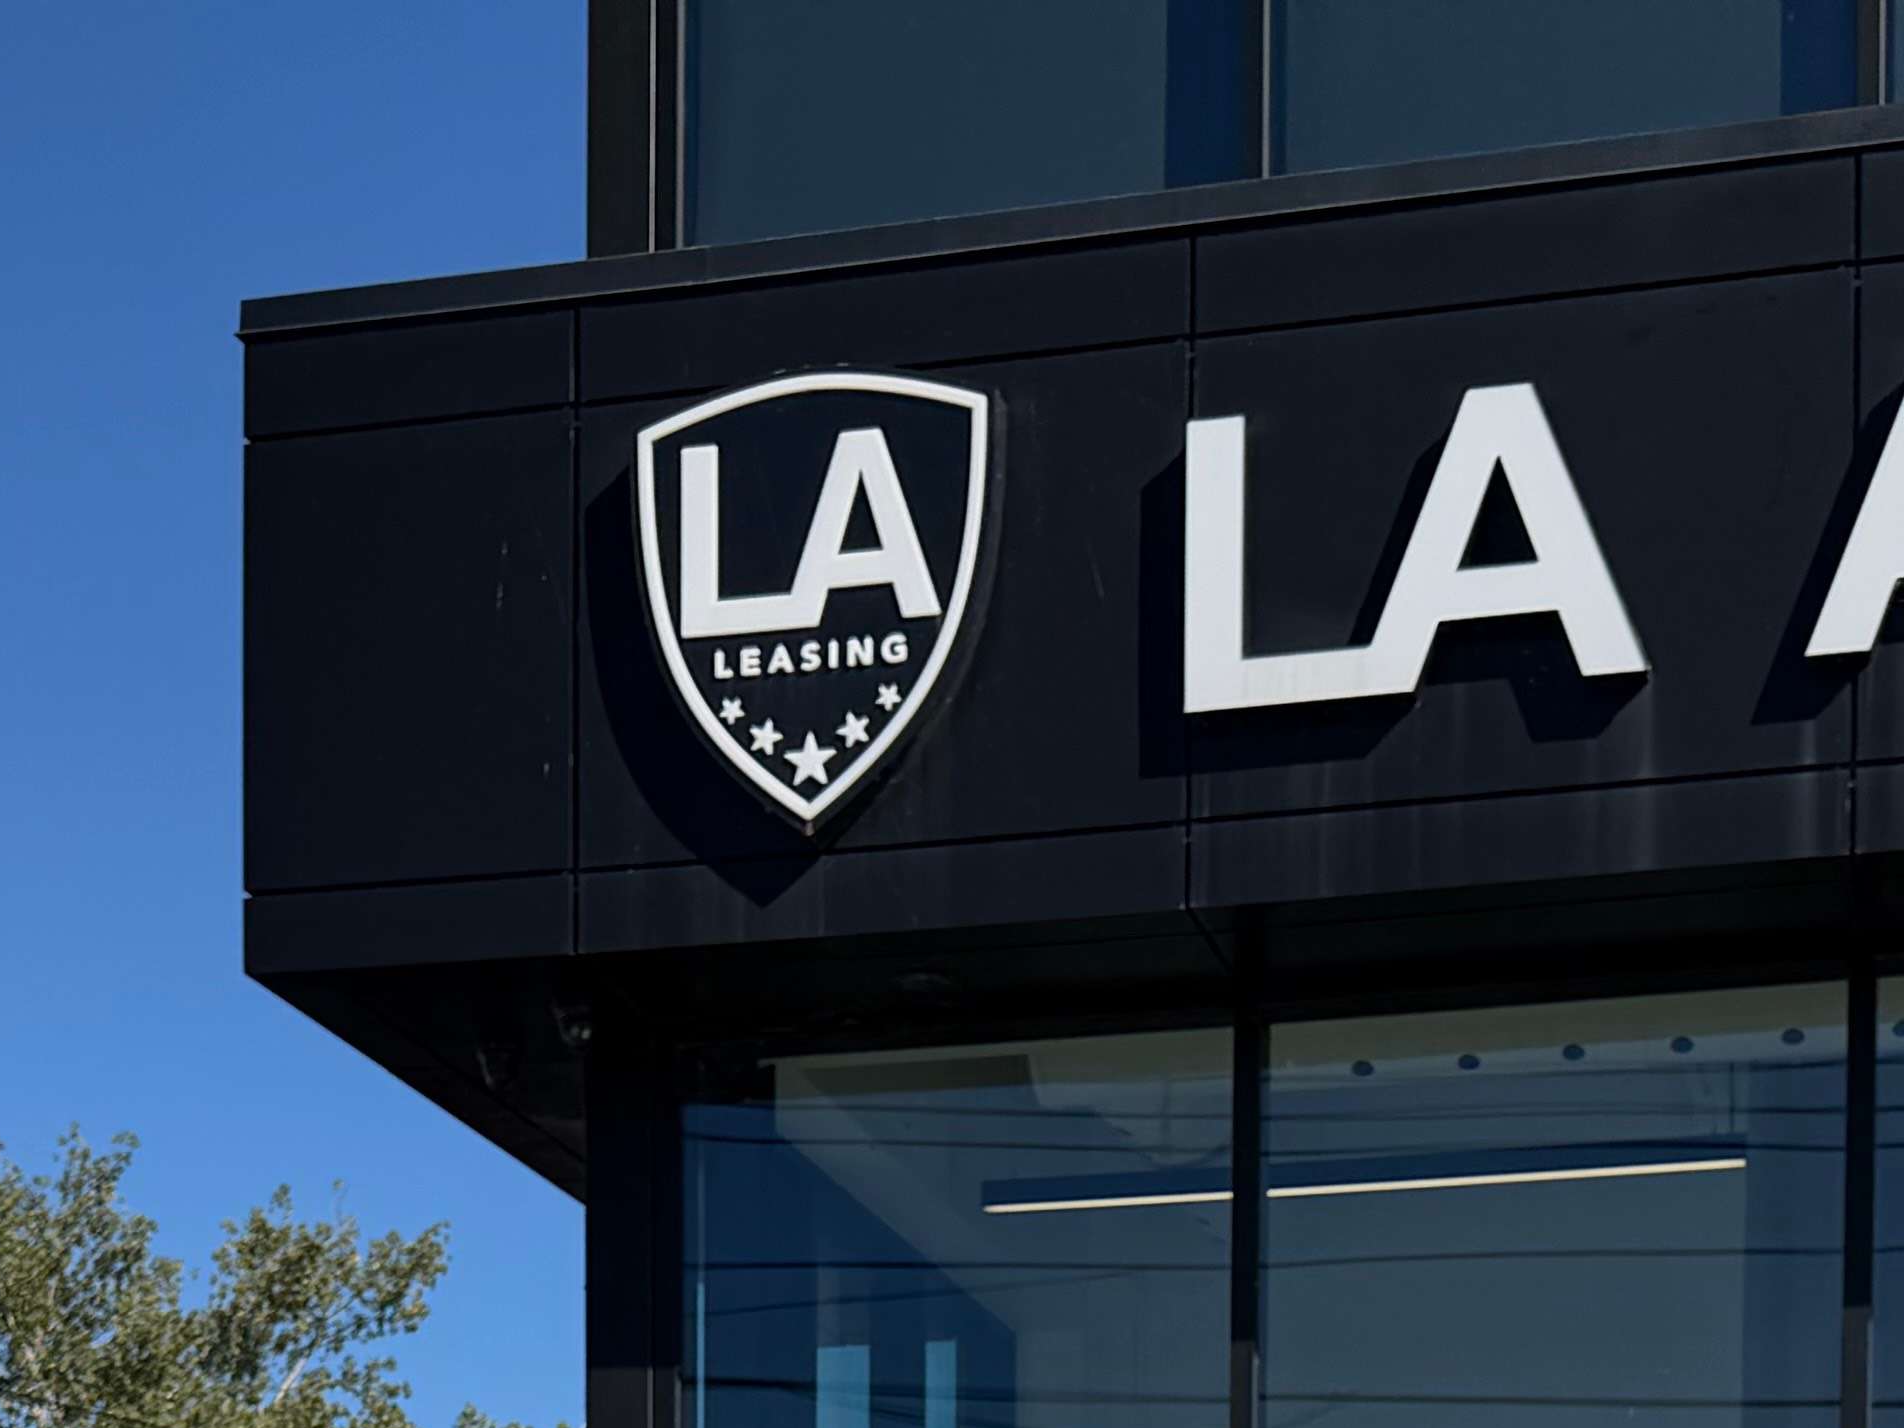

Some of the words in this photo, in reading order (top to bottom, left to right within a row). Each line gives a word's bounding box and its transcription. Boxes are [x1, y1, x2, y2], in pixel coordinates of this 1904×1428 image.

[680, 427, 942, 639] LA
[1184, 383, 1648, 713] LA
[714, 632, 909, 679] LEASING
